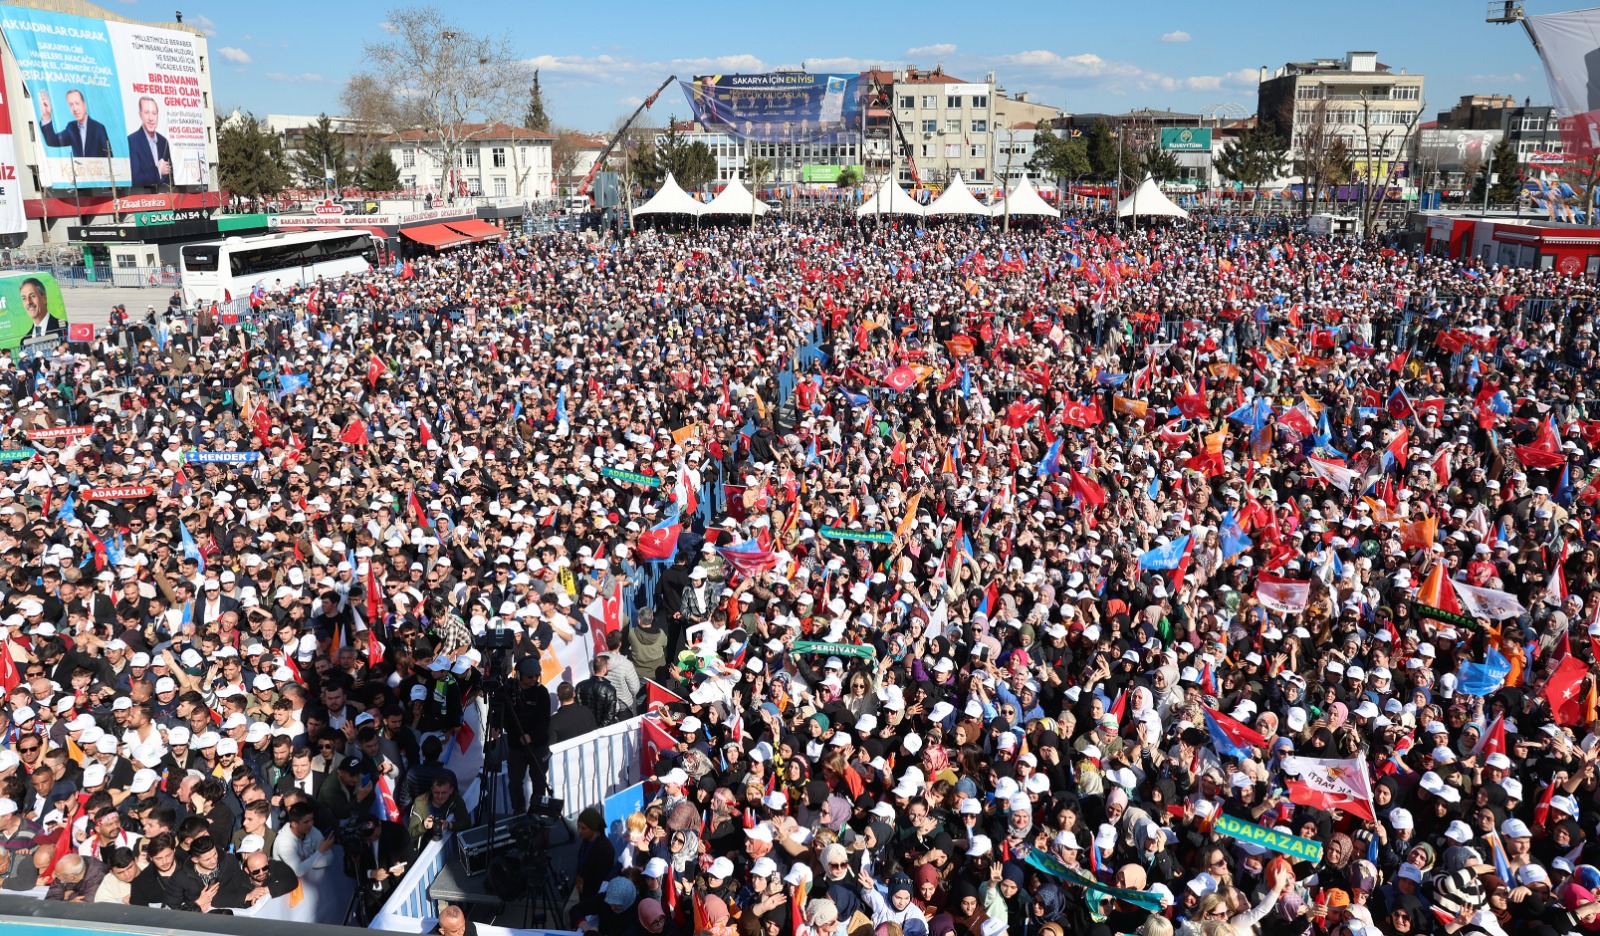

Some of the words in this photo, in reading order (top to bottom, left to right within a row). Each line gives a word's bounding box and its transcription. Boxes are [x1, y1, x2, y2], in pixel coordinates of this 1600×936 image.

[3, 19, 19, 30] AK
[19, 21, 68, 36] KADINLAR
[148, 73, 163, 83] BİR
[163, 75, 199, 86] DAVANIN
[732, 76, 768, 85] SAKARYA
[768, 75, 785, 85] İÇİN
[785, 76, 797, 84] EN
[797, 74, 815, 84] İYİSİ
[132, 83, 177, 95] NEFERLERİ
[178, 87, 200, 97] OLAN
[121, 199, 141, 209] Ziraat
[141, 198, 166, 208] Bankası
[316, 206, 342, 214] ÇAYKUR
[150, 211, 188, 223] DÜKKAN
[188, 210, 200, 219] 54
[344, 217, 367, 225] ÇAYKUR
[367, 217, 379, 225] ÇAY
[36, 427, 86, 438] ADAPAZARI
[199, 453, 247, 461] HENDEK
[608, 469, 653, 484] ADAPAZARI
[92, 488, 147, 498] ADAPAZARI
[828, 529, 885, 540] ADAPAZARI
[1417, 605, 1478, 630] ADAPAZARI
[811, 644, 857, 654] SERDİVAN
[1217, 815, 1321, 859] ADAPAZARI
